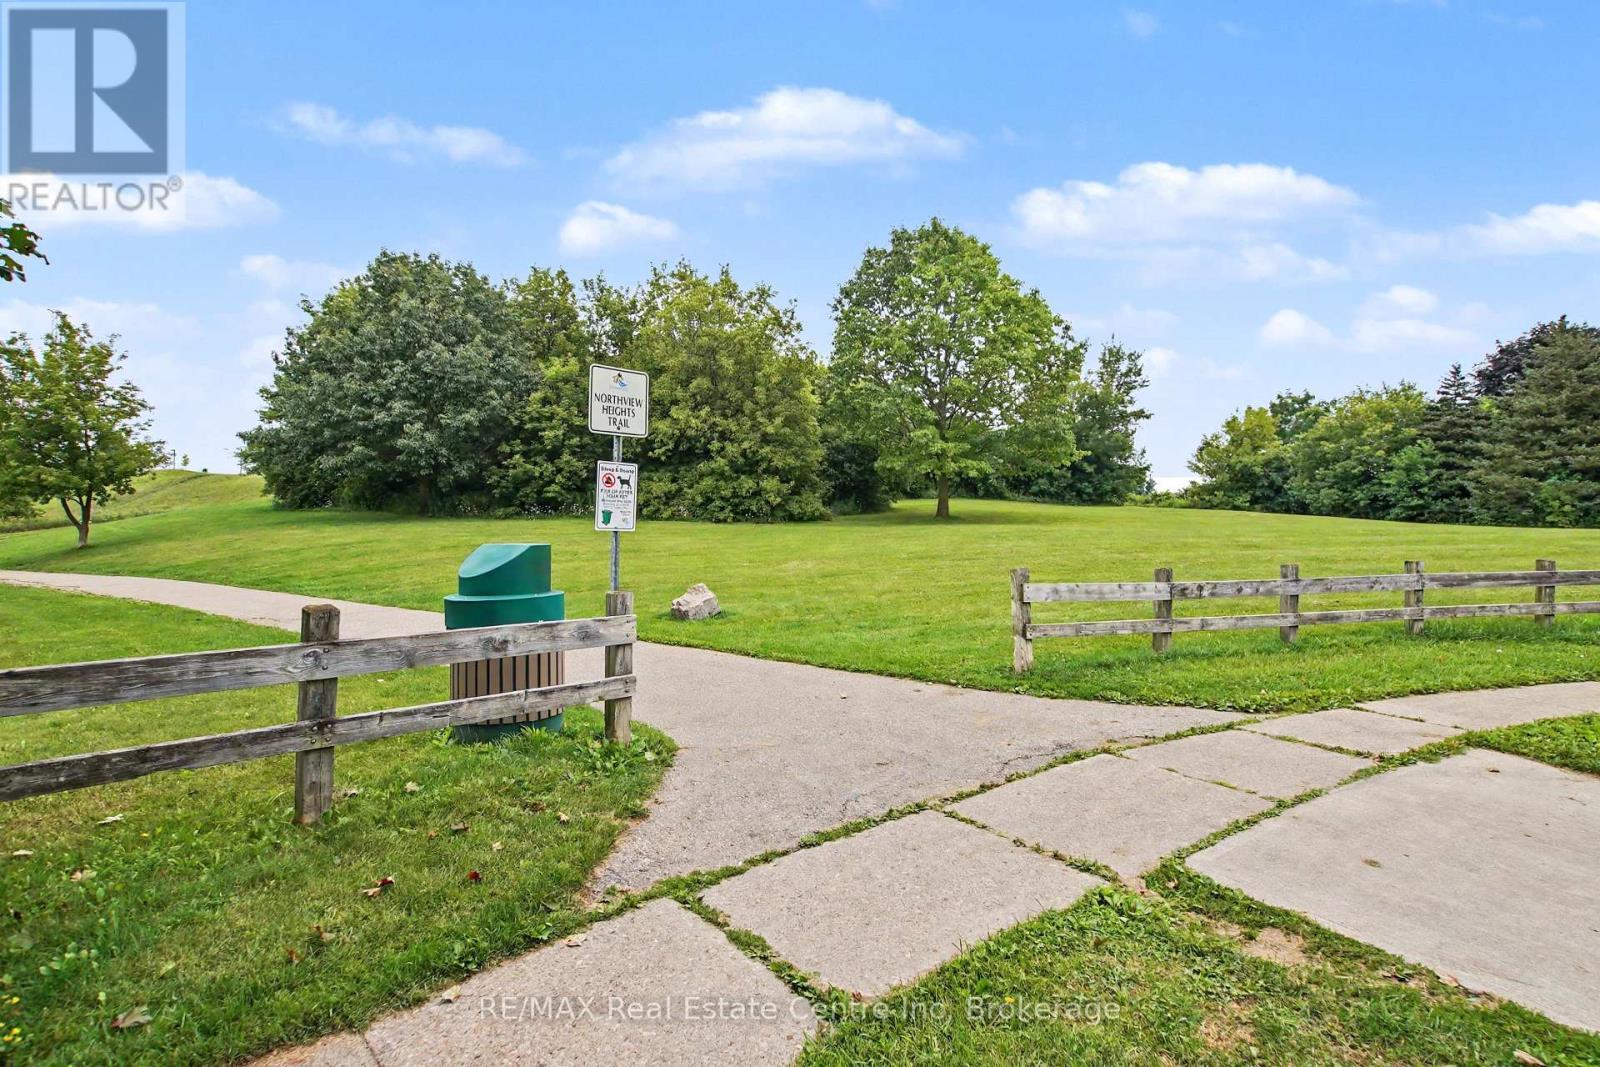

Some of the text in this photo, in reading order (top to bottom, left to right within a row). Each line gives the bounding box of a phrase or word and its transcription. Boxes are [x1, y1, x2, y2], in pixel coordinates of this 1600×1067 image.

[594, 392, 642, 408] NORTHVIEW
[602, 405, 636, 418] HEIGHTS
[608, 417, 630, 428] TRAIL
